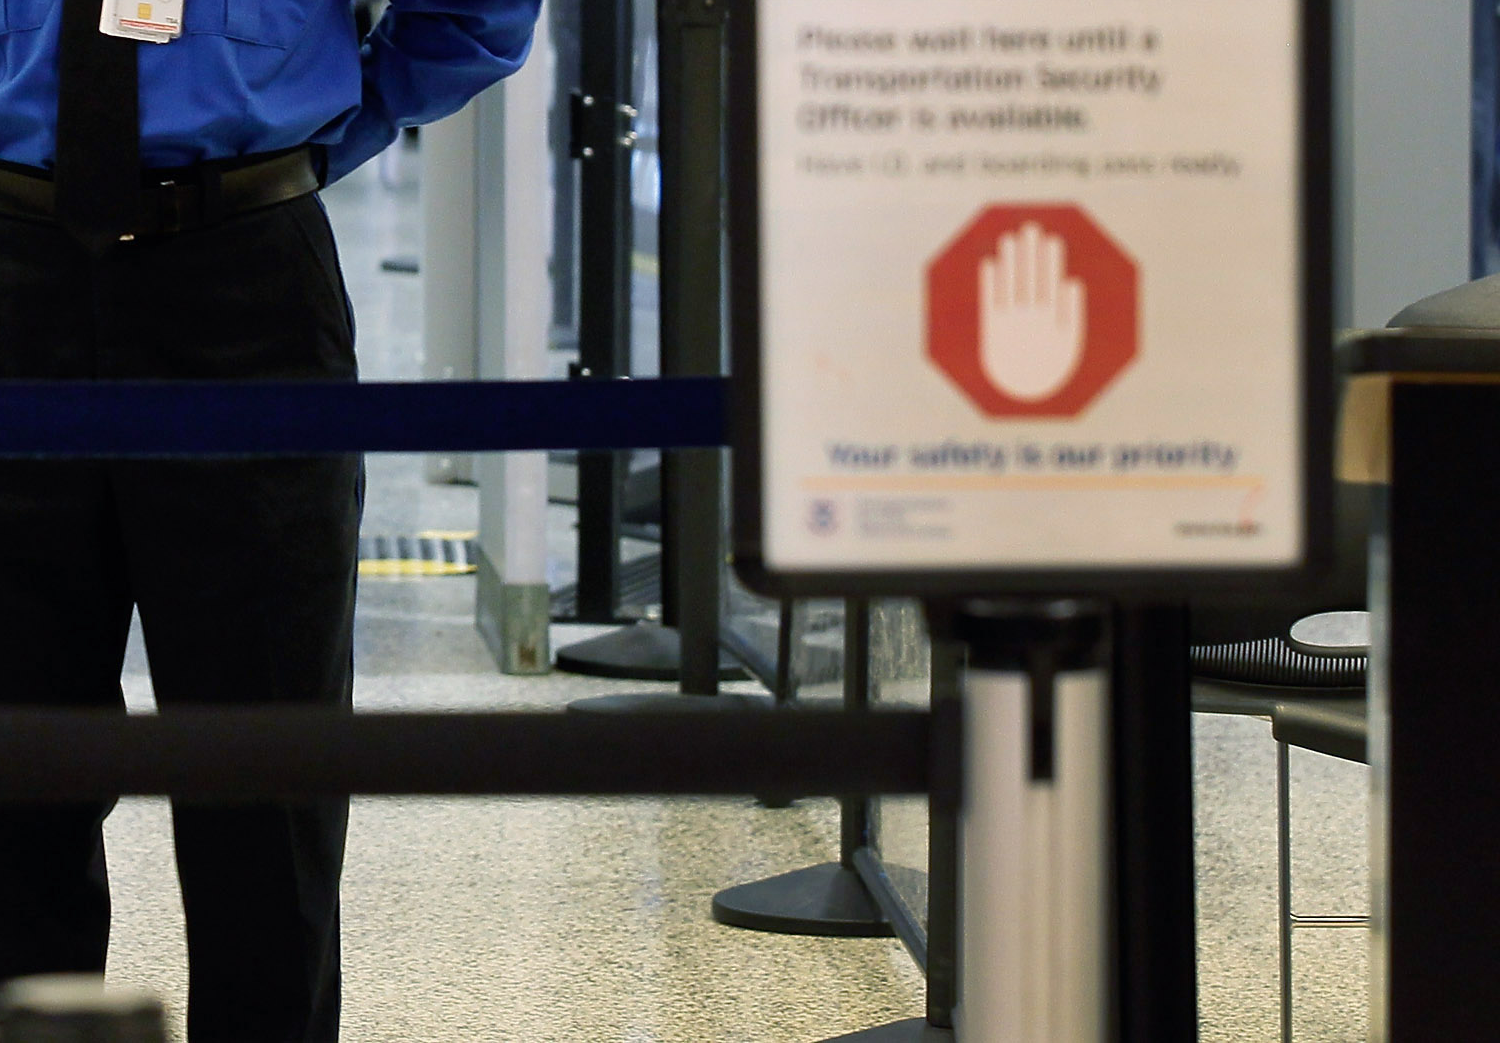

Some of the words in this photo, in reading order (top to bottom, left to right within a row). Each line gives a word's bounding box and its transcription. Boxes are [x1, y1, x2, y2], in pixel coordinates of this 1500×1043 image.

[799, 26, 895, 51] Please
[909, 26, 971, 51] wait
[985, 26, 1049, 51] here
[1062, 26, 1127, 51] until
[800, 64, 1024, 95] Transportation
[1038, 64, 1162, 95] Security
[799, 104, 900, 134] Officer
[824, 442, 898, 469] Your
[909, 440, 1006, 473] safety
[1018, 442, 1048, 469] is
[1055, 446, 1104, 469] our
[1111, 440, 1238, 473] priority
